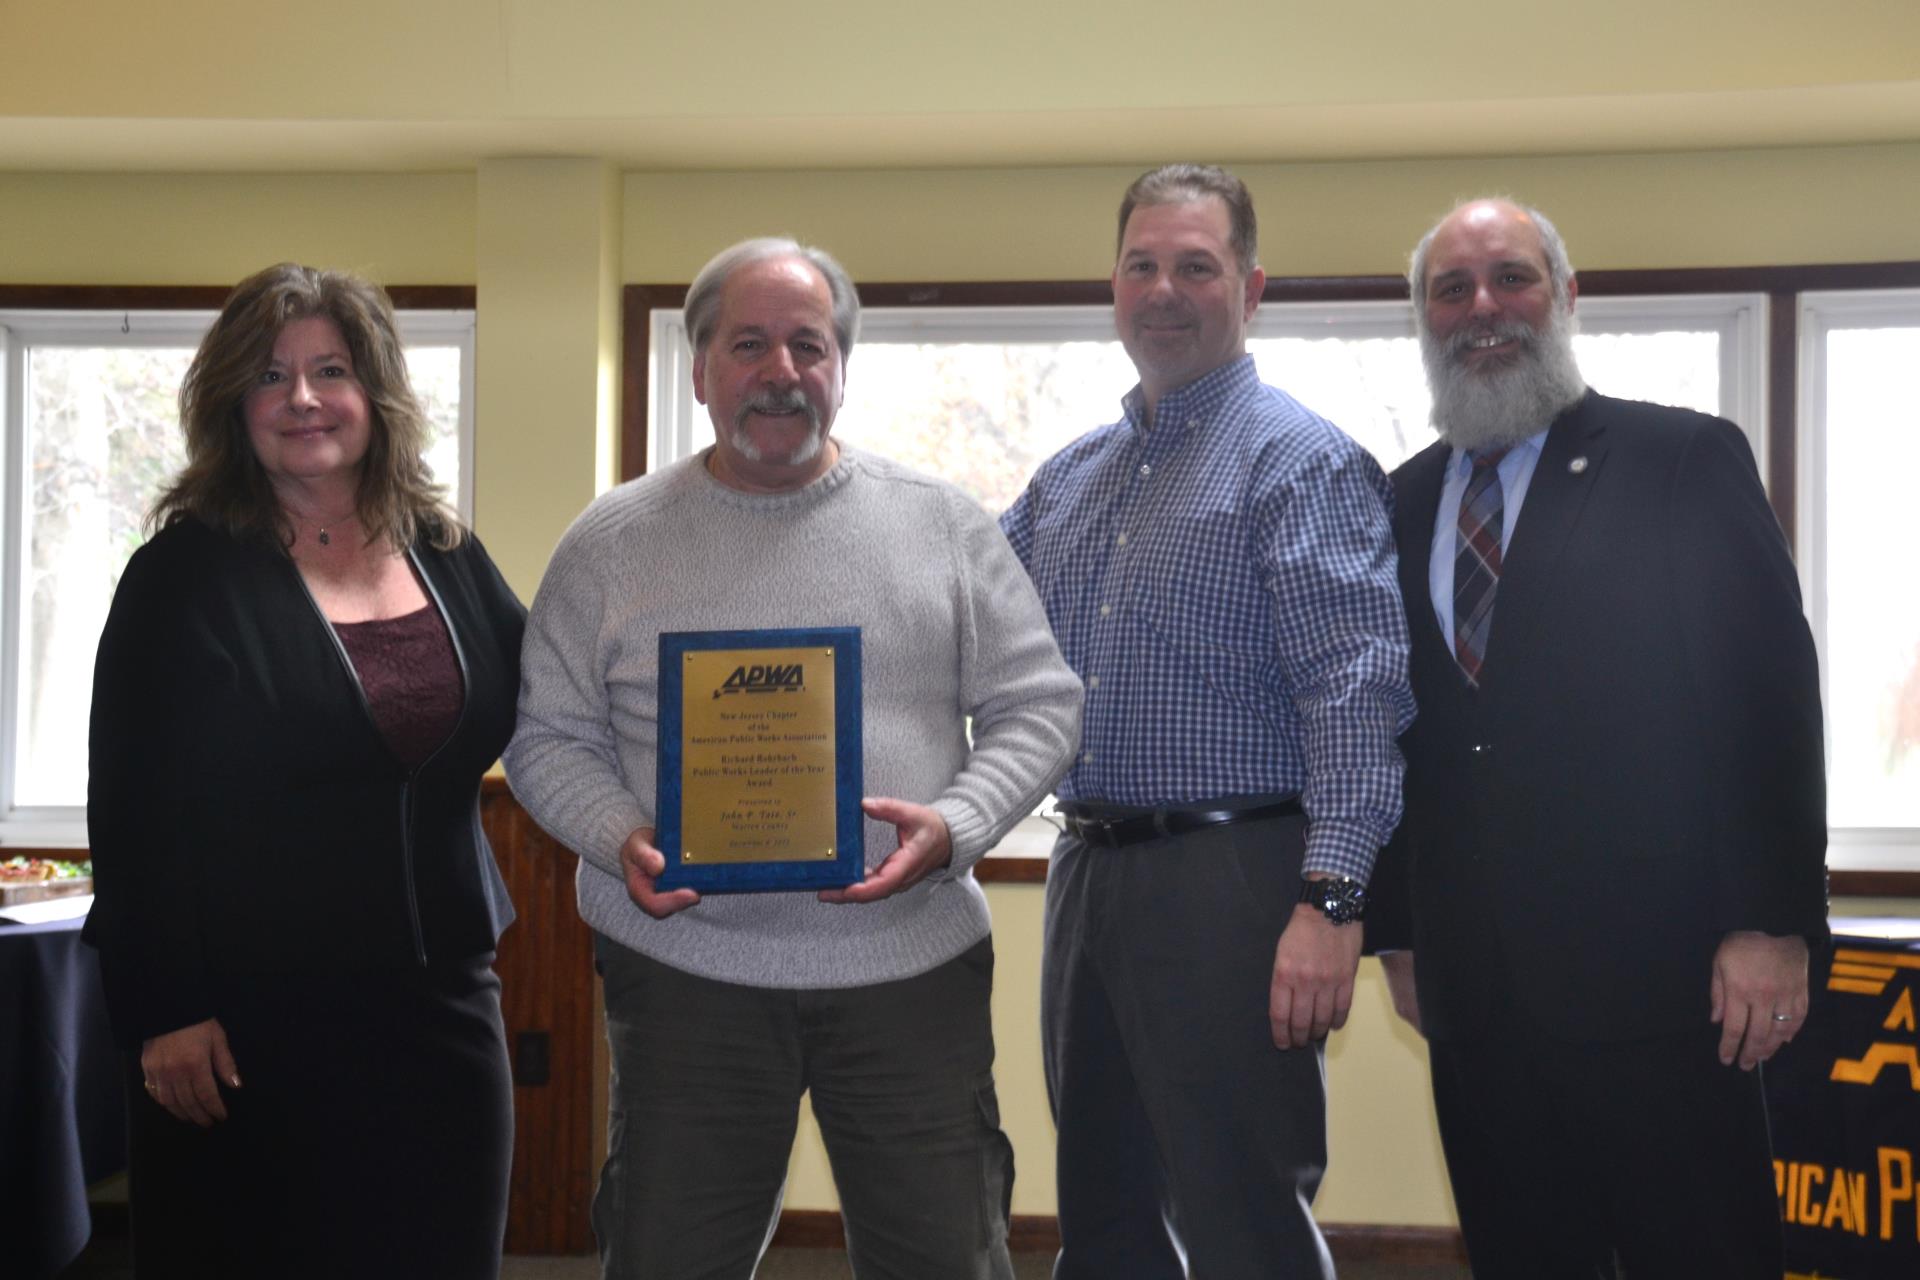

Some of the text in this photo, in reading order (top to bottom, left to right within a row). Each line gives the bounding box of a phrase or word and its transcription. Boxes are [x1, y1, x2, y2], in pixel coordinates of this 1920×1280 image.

[722, 664, 803, 687] APWA
[720, 710, 798, 721] New Jersey Chapter
[747, 723, 770, 731] of the
[691, 732, 827, 744] American Public Works Association
[721, 754, 754, 764] Richard
[693, 764, 825, 776] Public Works Leader of the Year
[746, 778, 773, 787] Award
